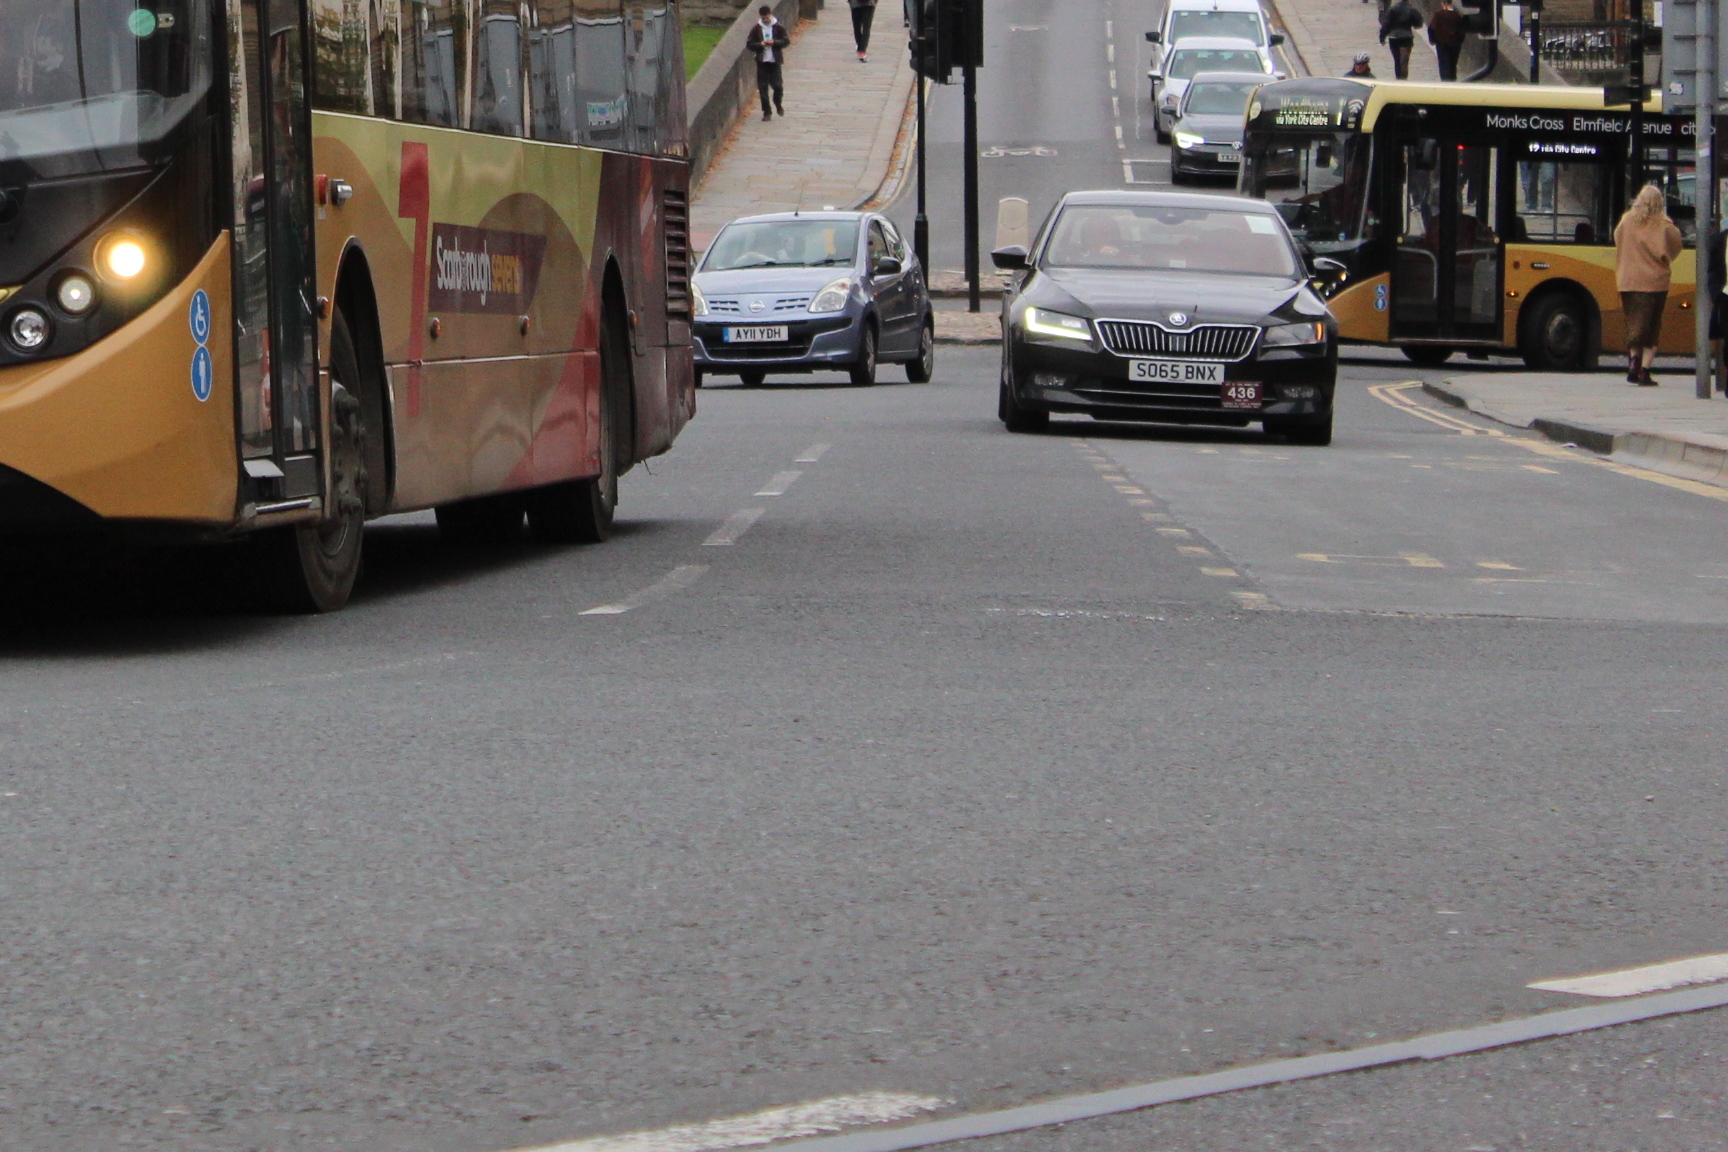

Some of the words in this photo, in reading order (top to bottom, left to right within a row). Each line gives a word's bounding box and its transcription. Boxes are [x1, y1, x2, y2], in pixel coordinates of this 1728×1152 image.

[1487, 114, 1528, 129] Monks
[1529, 115, 1564, 131] Cross
[735, 329, 756, 340] AY11
[759, 328, 781, 339] YDH
[1137, 362, 1180, 379] SO65
[1184, 364, 1217, 381] BNX
[1227, 387, 1256, 399] 436
